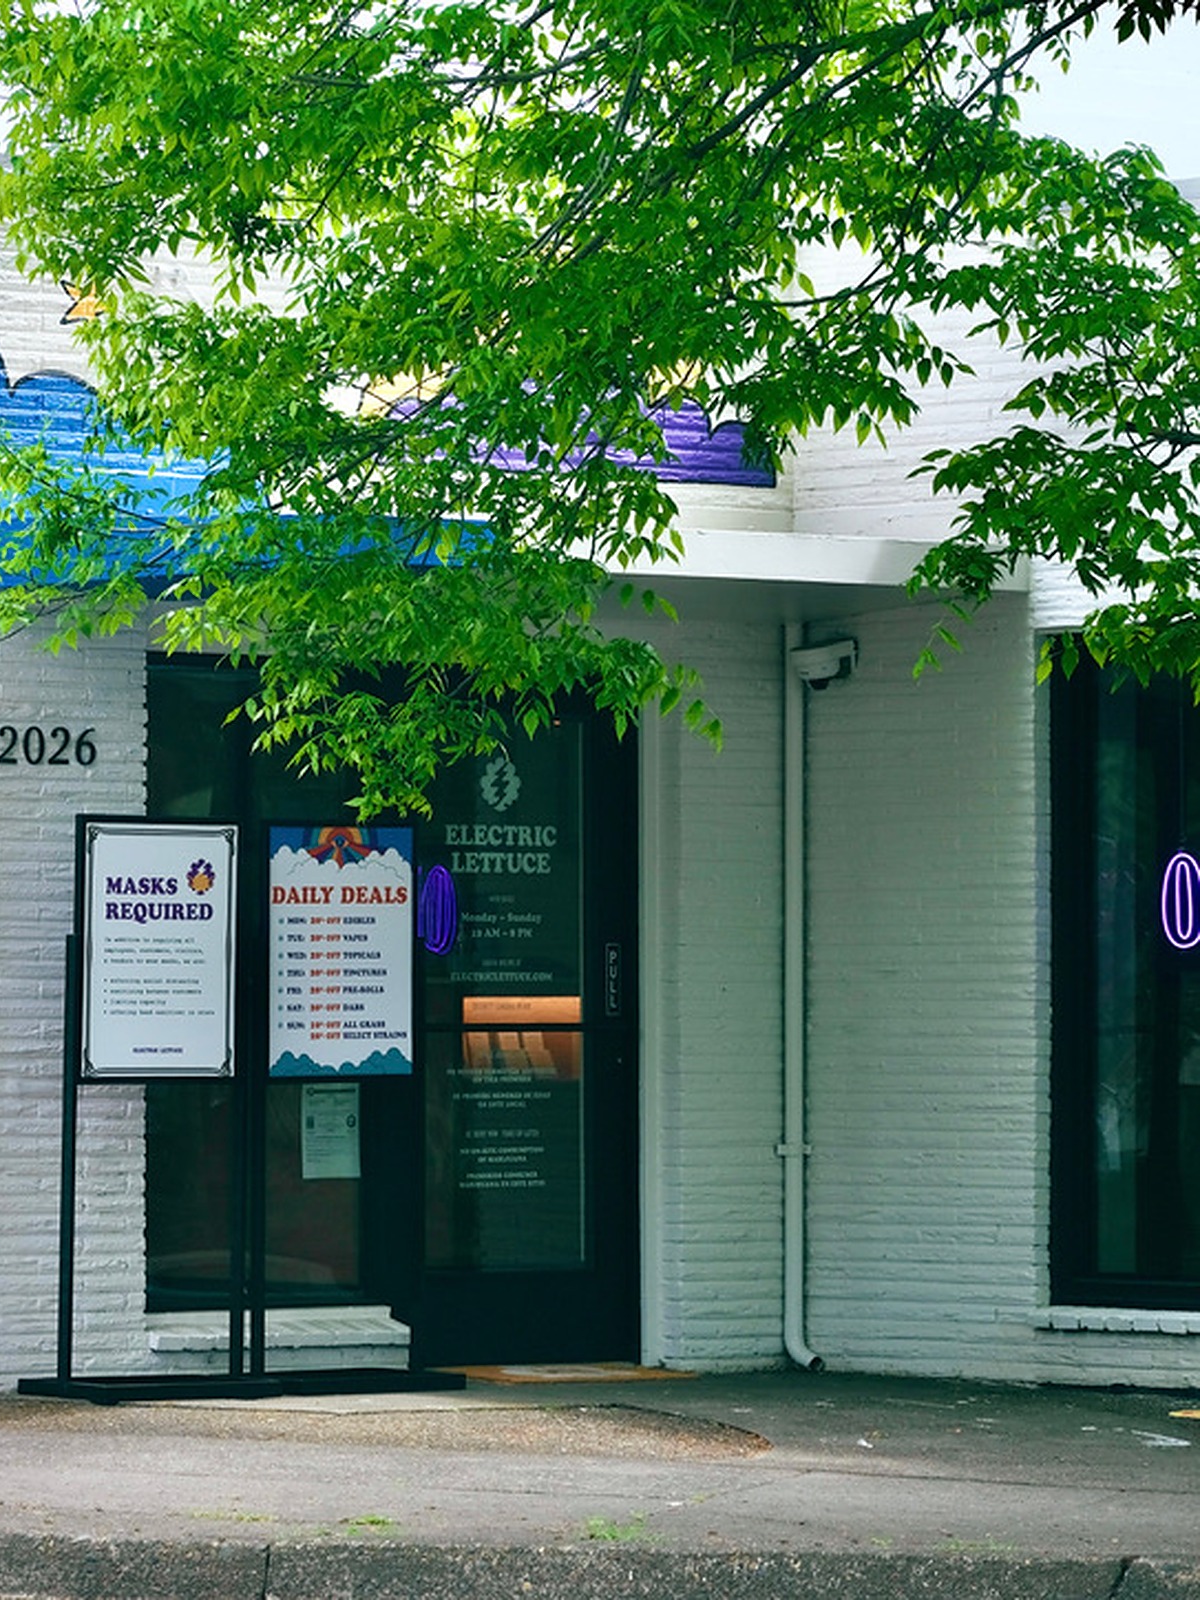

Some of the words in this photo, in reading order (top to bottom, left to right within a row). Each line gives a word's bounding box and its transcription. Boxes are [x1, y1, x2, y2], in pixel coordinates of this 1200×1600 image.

[445, 823, 557, 848] ELECTRIC
[451, 852, 551, 875] LETTUCE
[105, 877, 179, 896] MASKS
[271, 886, 335, 905] DAILY
[340, 886, 408, 905] DEALS
[104, 902, 214, 924] REQUIRED
[608, 949, 618, 1009] PULL
